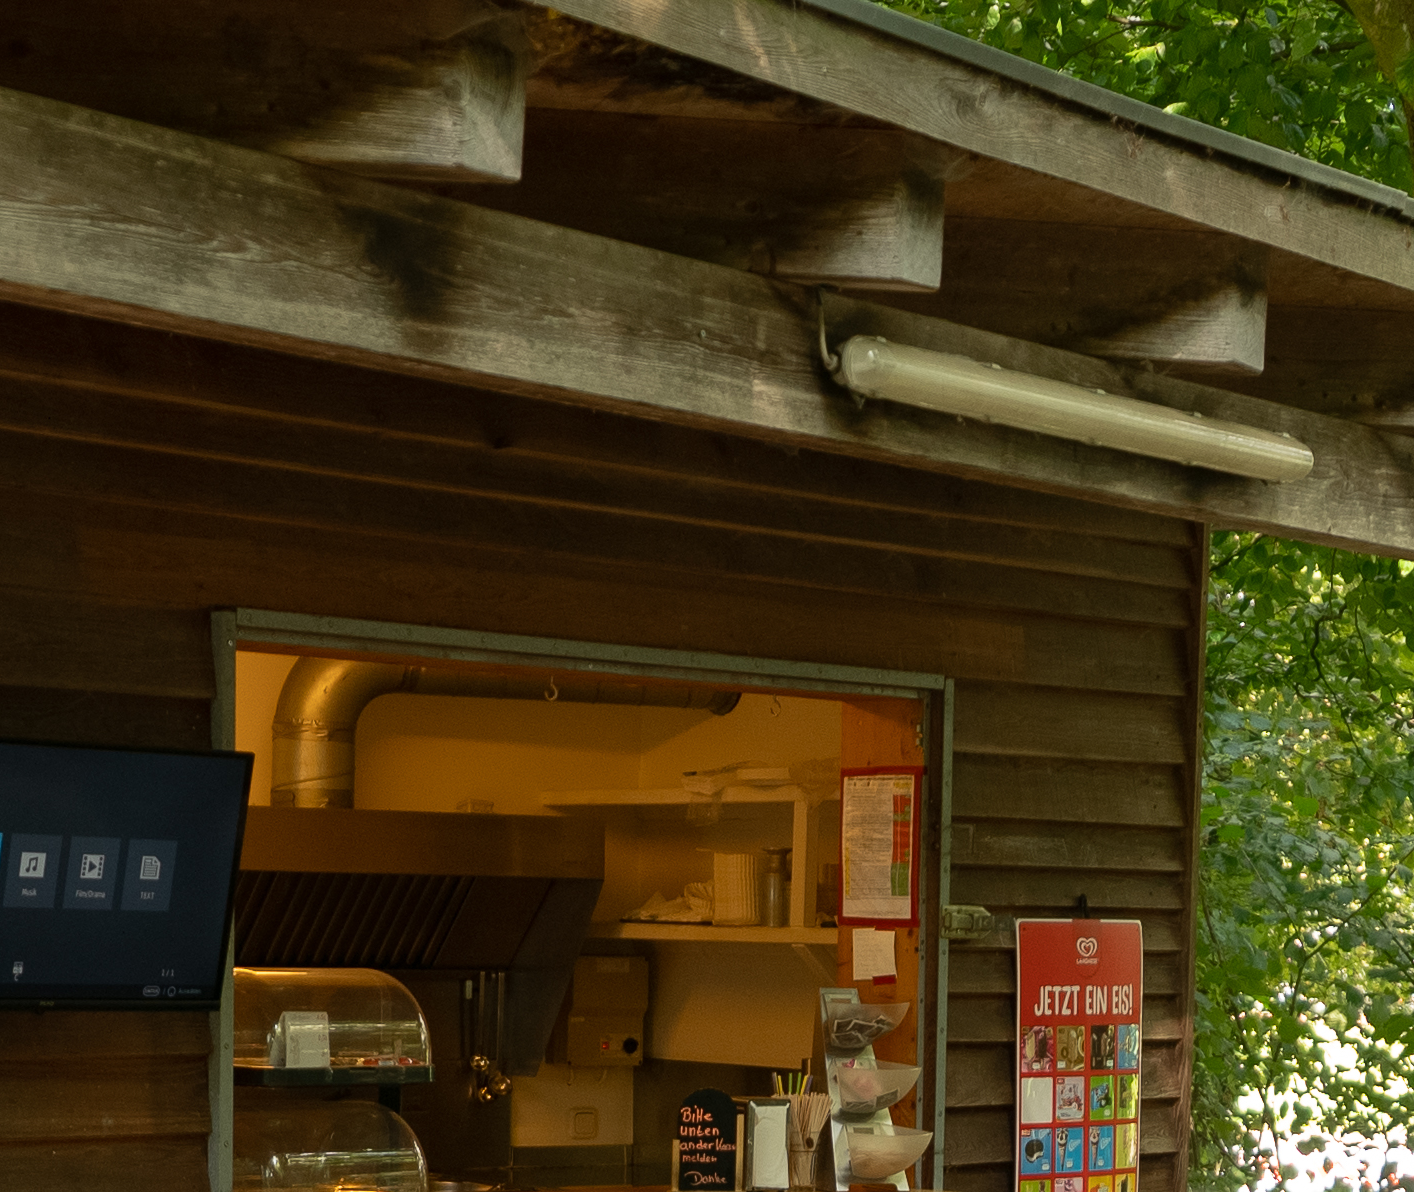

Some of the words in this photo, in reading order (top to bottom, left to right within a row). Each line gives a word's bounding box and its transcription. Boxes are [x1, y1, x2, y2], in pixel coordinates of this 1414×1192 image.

[21, 888, 37, 897] Musik
[140, 891, 155, 900] TEXT
[1034, 985, 1081, 1016] JETZT
[1085, 985, 1108, 1016] EIN
[1112, 983, 1133, 1016] EIS!
[681, 1105, 713, 1123] Bitte
[680, 1125, 720, 1137] unten
[682, 1152, 717, 1163] melden
[684, 1171, 727, 1186] Danke
